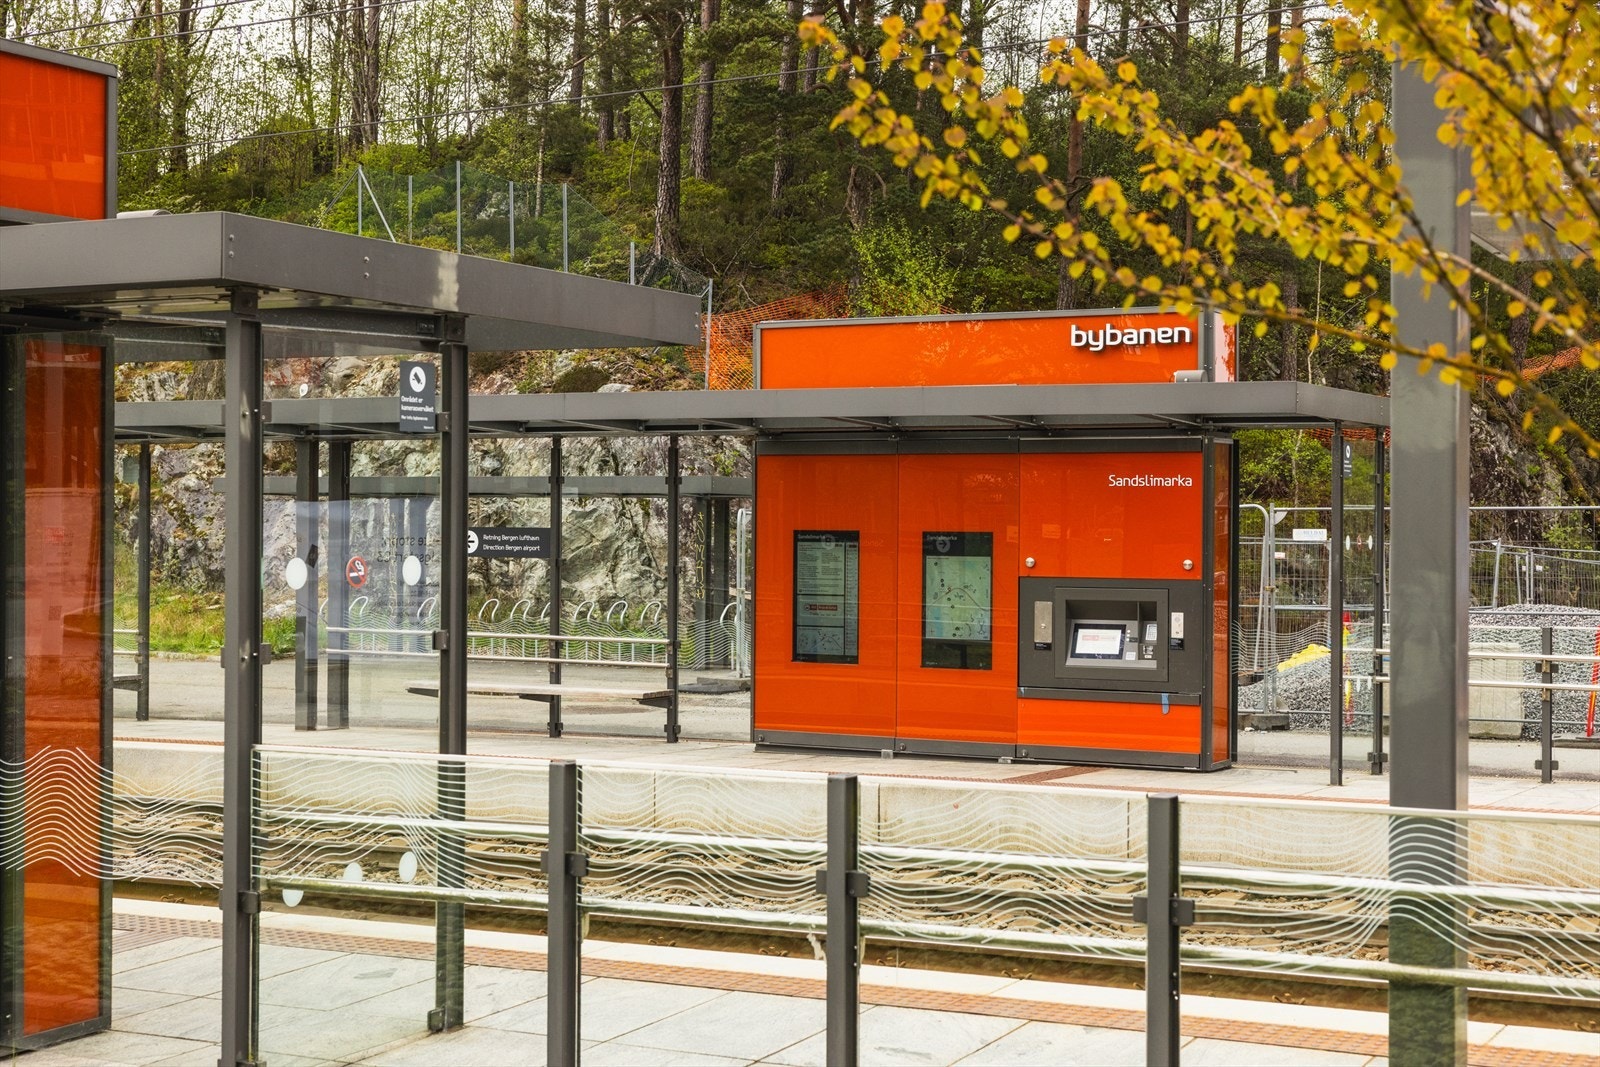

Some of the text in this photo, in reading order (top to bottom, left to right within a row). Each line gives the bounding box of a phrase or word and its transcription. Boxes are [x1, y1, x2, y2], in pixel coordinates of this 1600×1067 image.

[1070, 323, 1192, 351] bybanen
[1108, 474, 1193, 487] Sandslimarka
[501, 534, 519, 542] Bergen
[505, 544, 523, 552] Bergen
